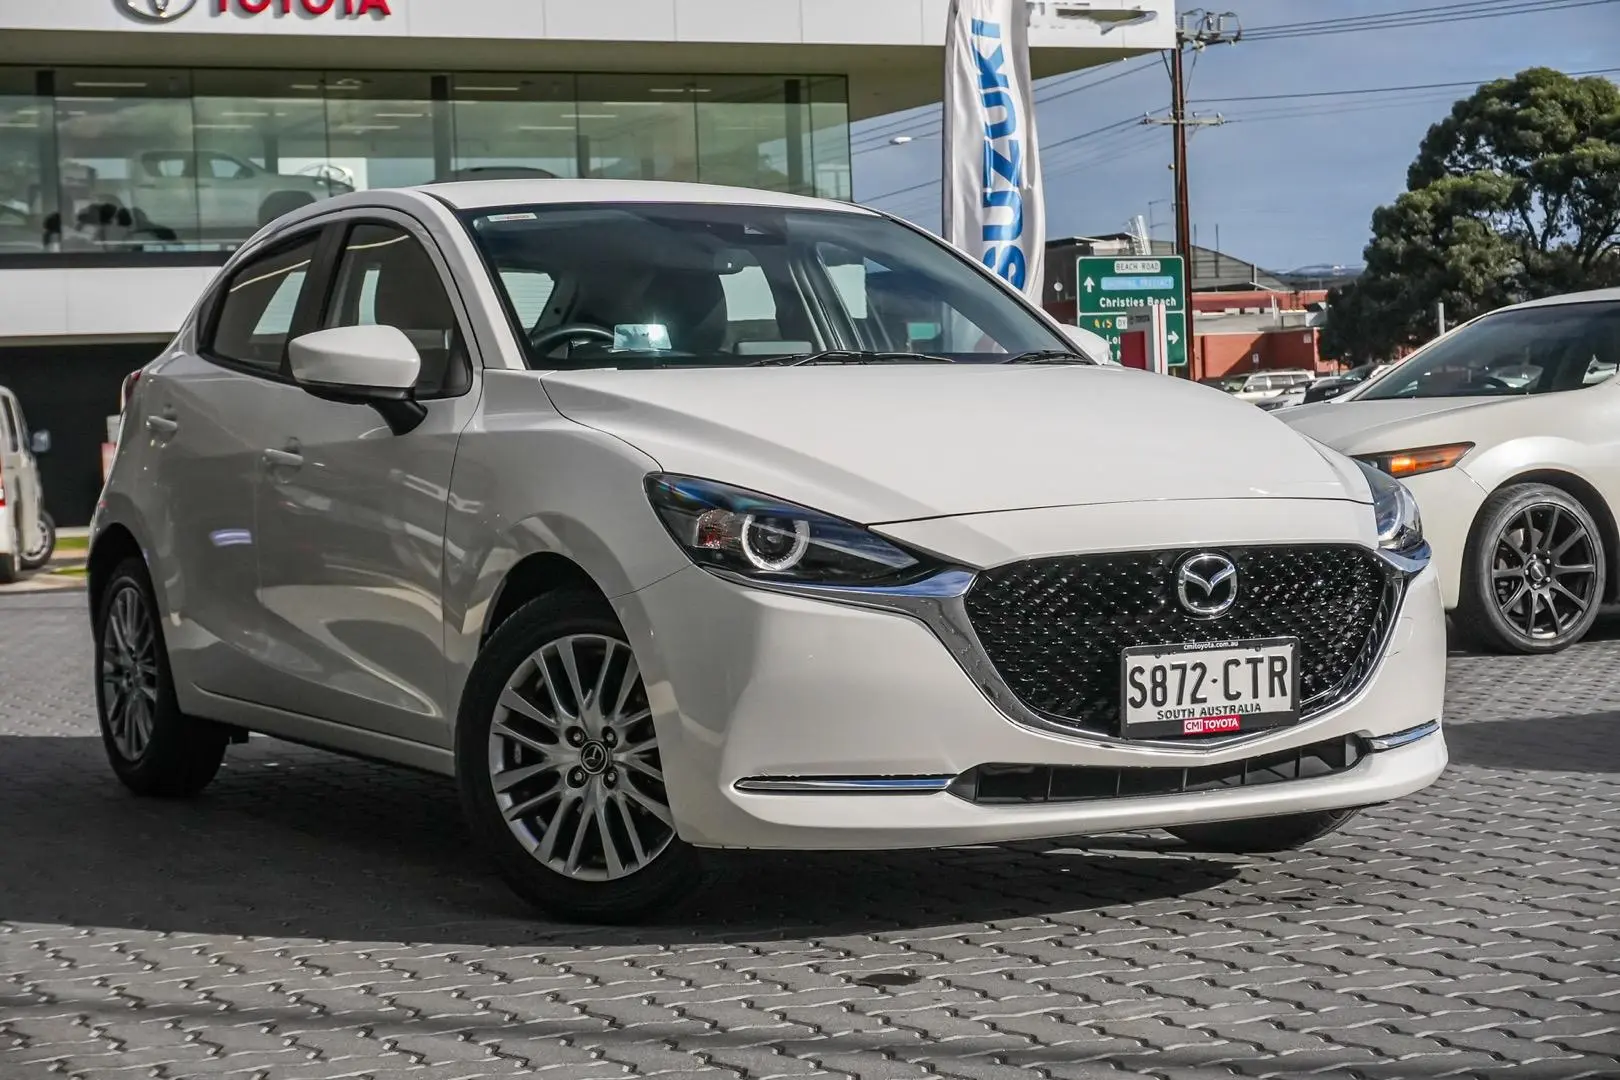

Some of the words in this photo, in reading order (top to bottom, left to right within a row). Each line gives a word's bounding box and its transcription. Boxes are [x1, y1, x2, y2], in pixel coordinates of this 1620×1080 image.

[971, 18, 1027, 291] SUZUKI
[1116, 263, 1138, 271] BEACH
[1141, 262, 1160, 271] ROAD
[1099, 297, 1145, 308] Christies
[1147, 296, 1177, 307] Beach
[1183, 640, 1239, 651] cmitoyota.com.au
[1157, 707, 1195, 720] SOUTH
[1200, 703, 1262, 716] AUSTRALIA
[1185, 720, 1203, 732] CMI
[1203, 718, 1239, 730] TOYOTA
